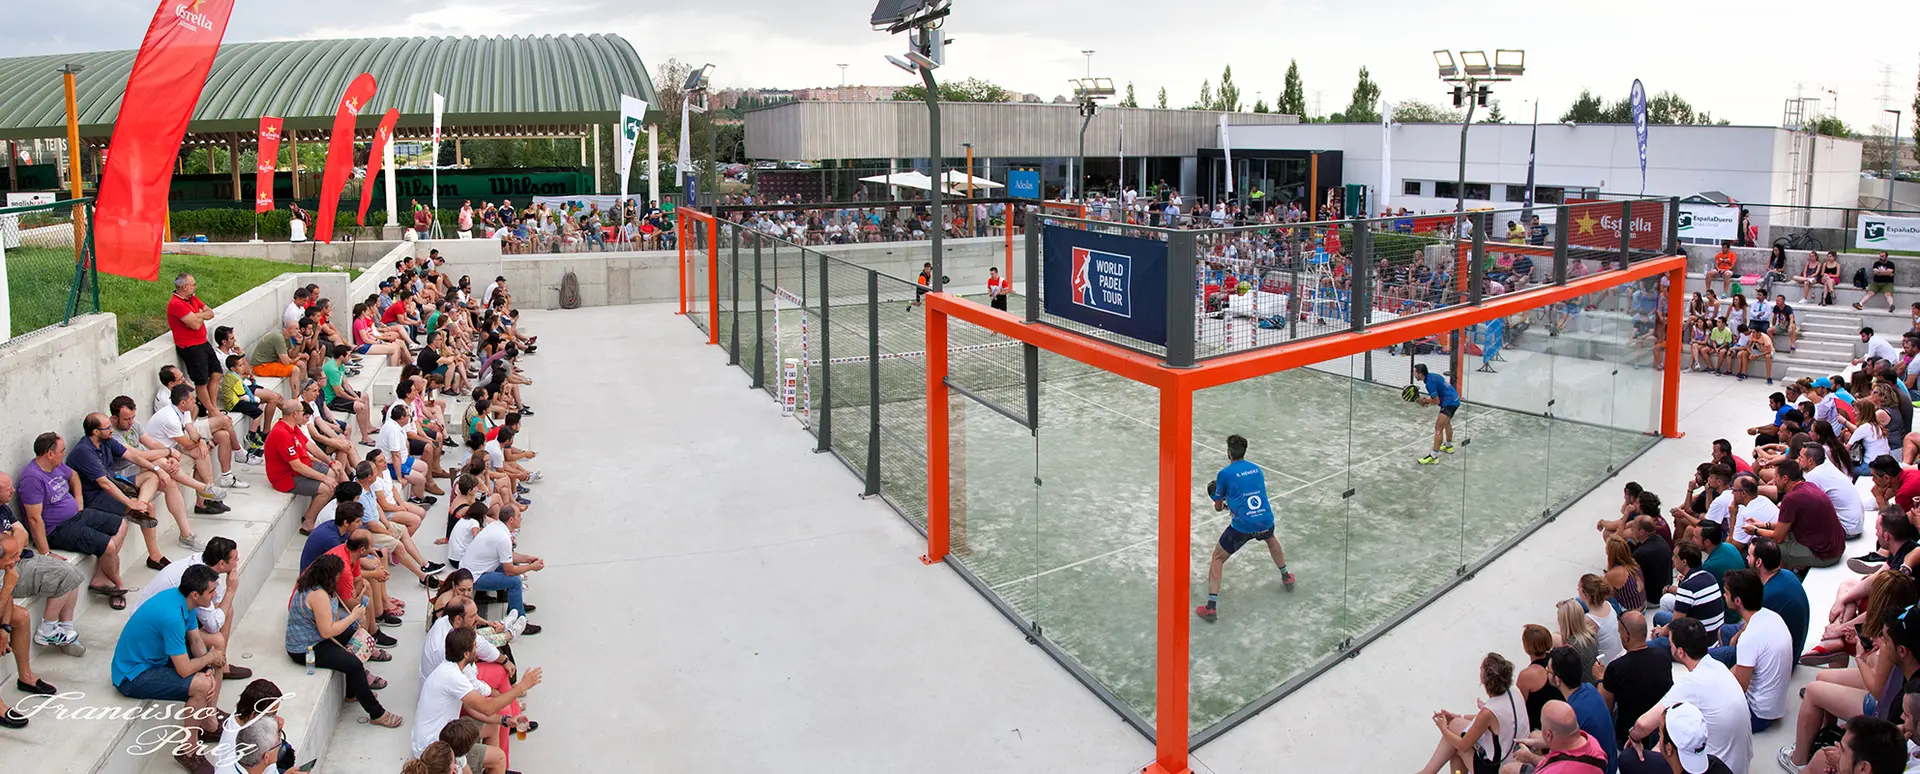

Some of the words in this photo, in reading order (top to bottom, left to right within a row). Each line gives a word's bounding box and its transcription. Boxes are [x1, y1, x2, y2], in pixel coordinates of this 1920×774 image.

[488, 176, 567, 195] Wilson
[1600, 215, 1652, 232] Estella
[1693, 215, 1733, 223] EspañaDuero
[1096, 259, 1124, 277] WORLD
[1099, 275, 1123, 292] PADEL
[1102, 290, 1123, 306] TOUR
[288, 446, 296, 456] 5
